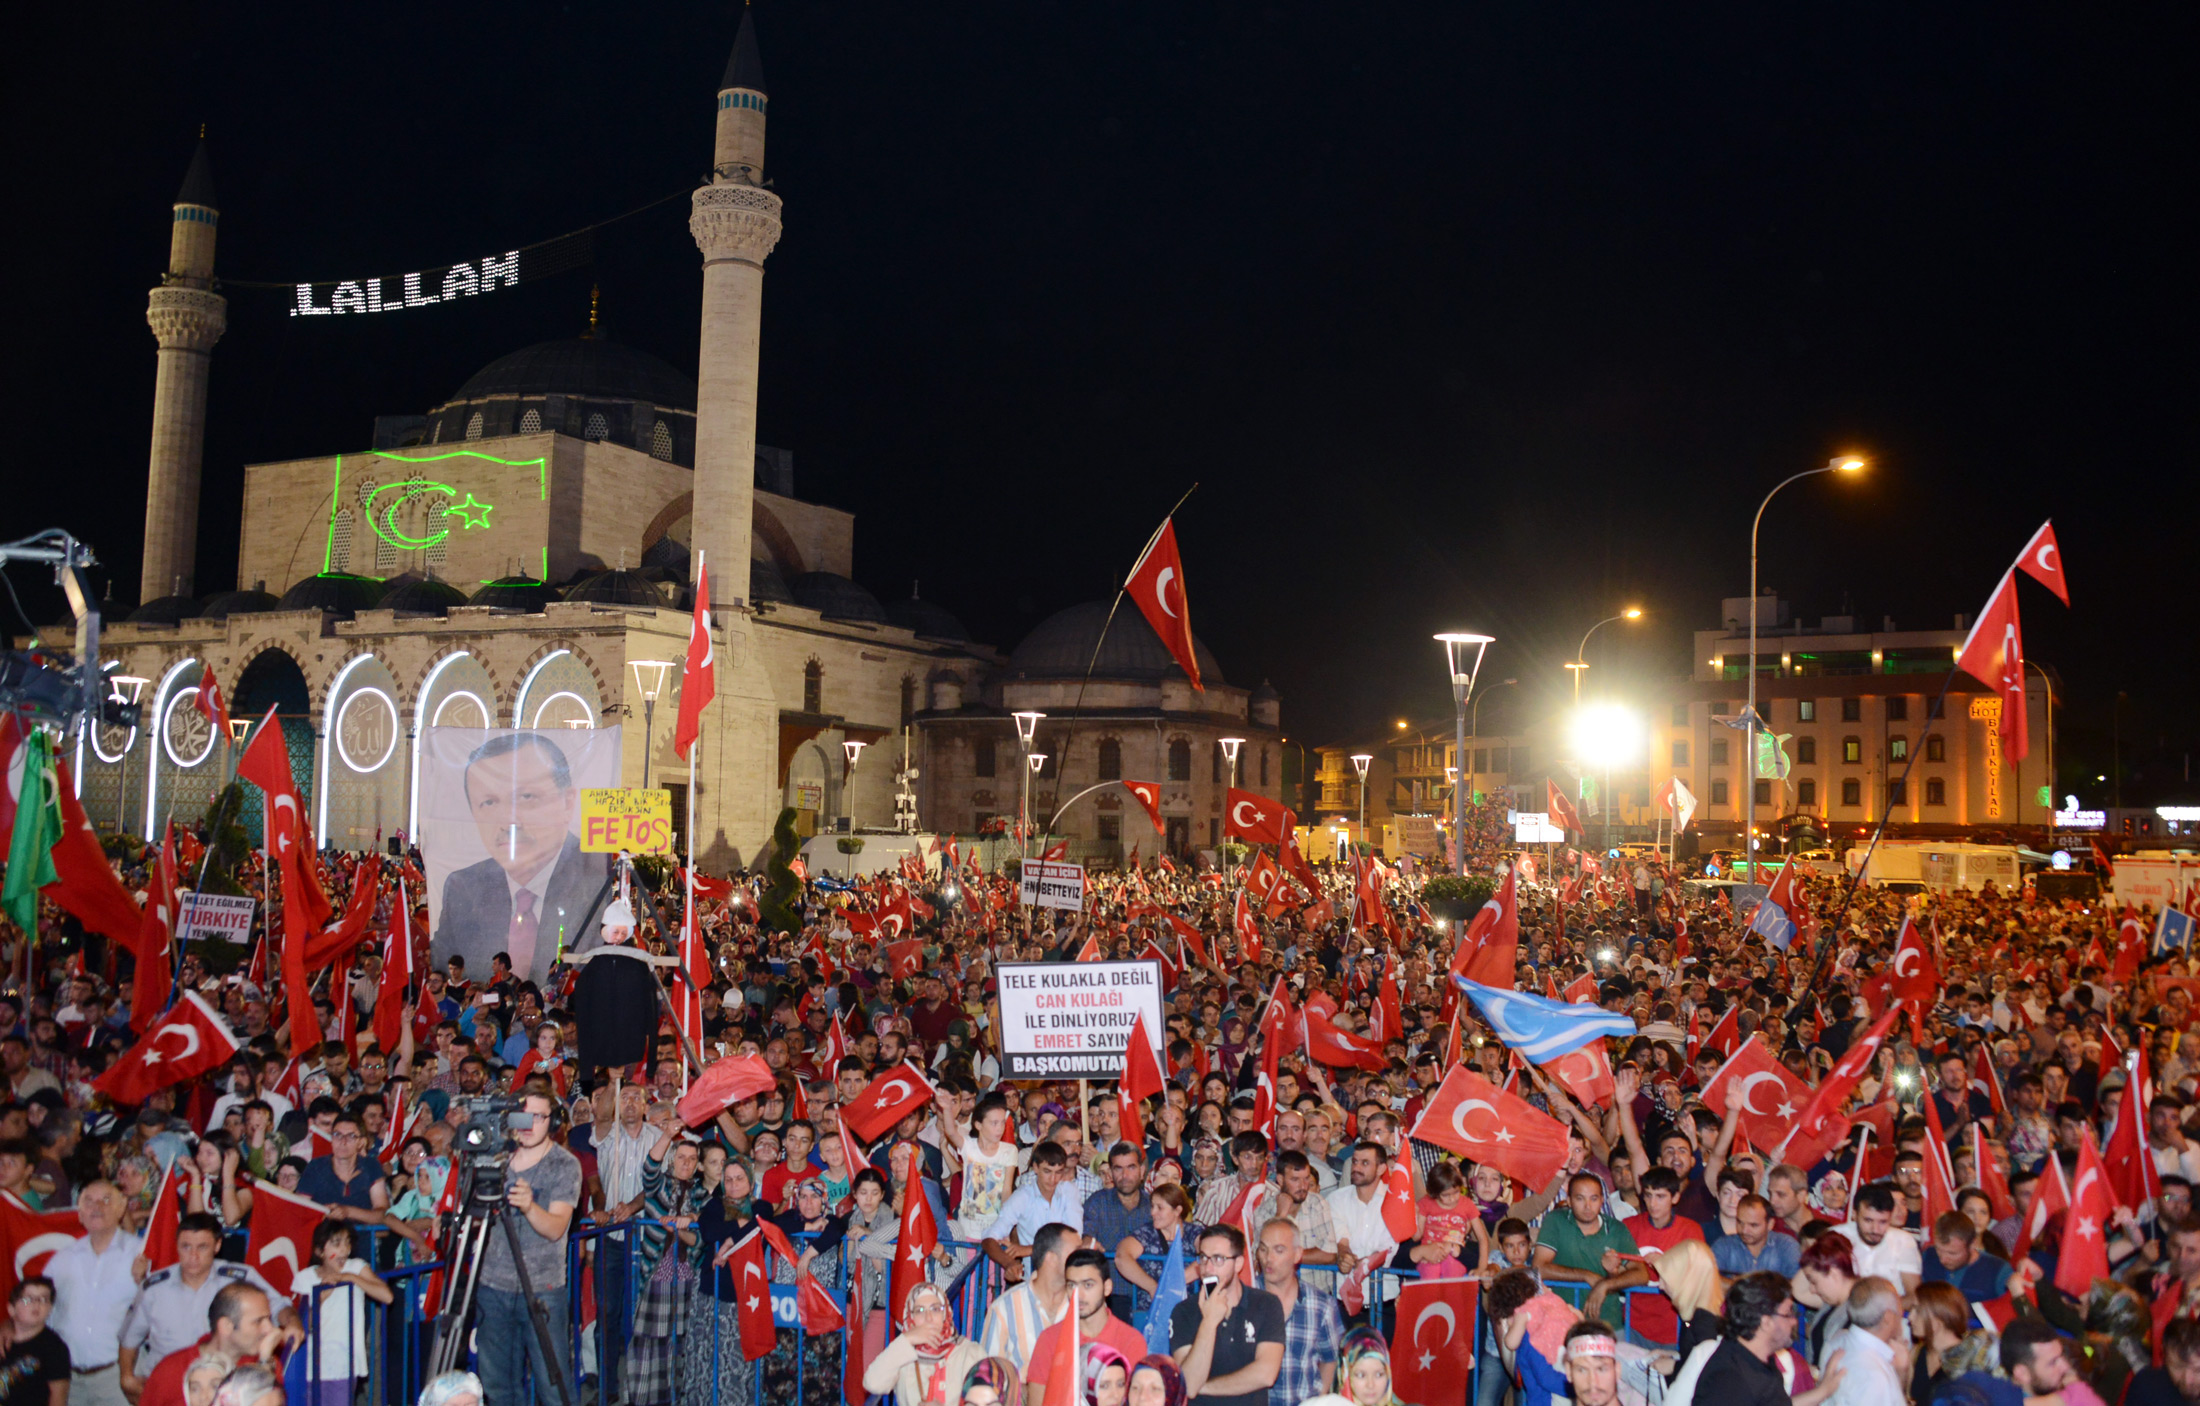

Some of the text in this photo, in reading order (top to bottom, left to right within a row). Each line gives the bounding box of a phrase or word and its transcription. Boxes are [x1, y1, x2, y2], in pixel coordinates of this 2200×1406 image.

[1971, 707, 1998, 717] HOT
[1058, 867, 1078, 879] İÇİN
[216, 896, 253, 909] EĞİLMEZ
[183, 907, 249, 929] TÜRKİYE
[1004, 968, 1153, 989] TELE KULAKLA DEĞİL
[1036, 989, 1123, 1009] CAN KULAĞI
[1025, 1010, 1136, 1029] İLE DİNLİYORUZ
[1034, 1034, 1083, 1049] EMRET
[771, 1295, 802, 1323] PO
